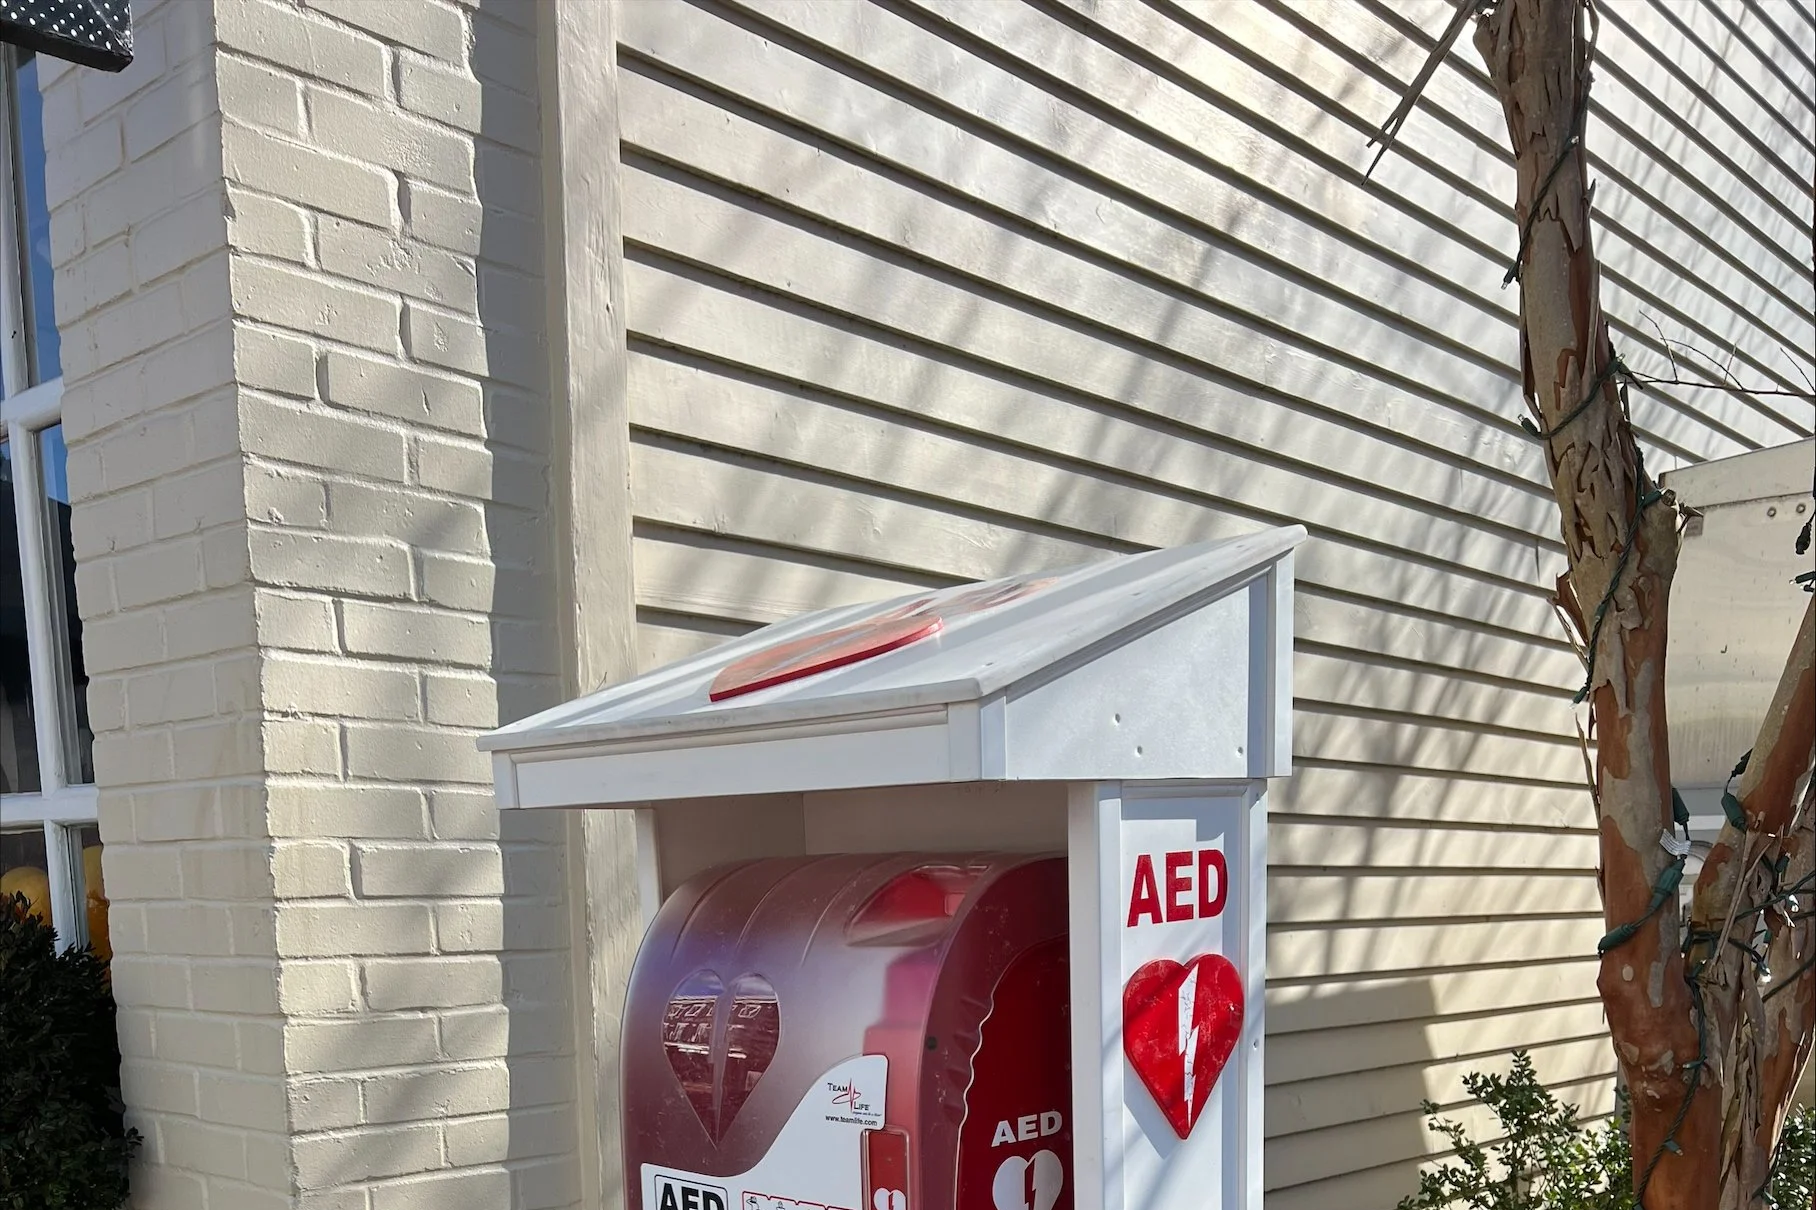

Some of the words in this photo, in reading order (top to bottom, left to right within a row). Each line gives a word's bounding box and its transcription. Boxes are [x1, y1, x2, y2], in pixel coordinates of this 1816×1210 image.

[1127, 849, 1228, 927] AED
[827, 1082, 848, 1092] TEAM
[854, 1101, 870, 1110] LIFE
[825, 1115, 877, 1126] www.teamlife.com
[991, 1110, 1063, 1147] AED
